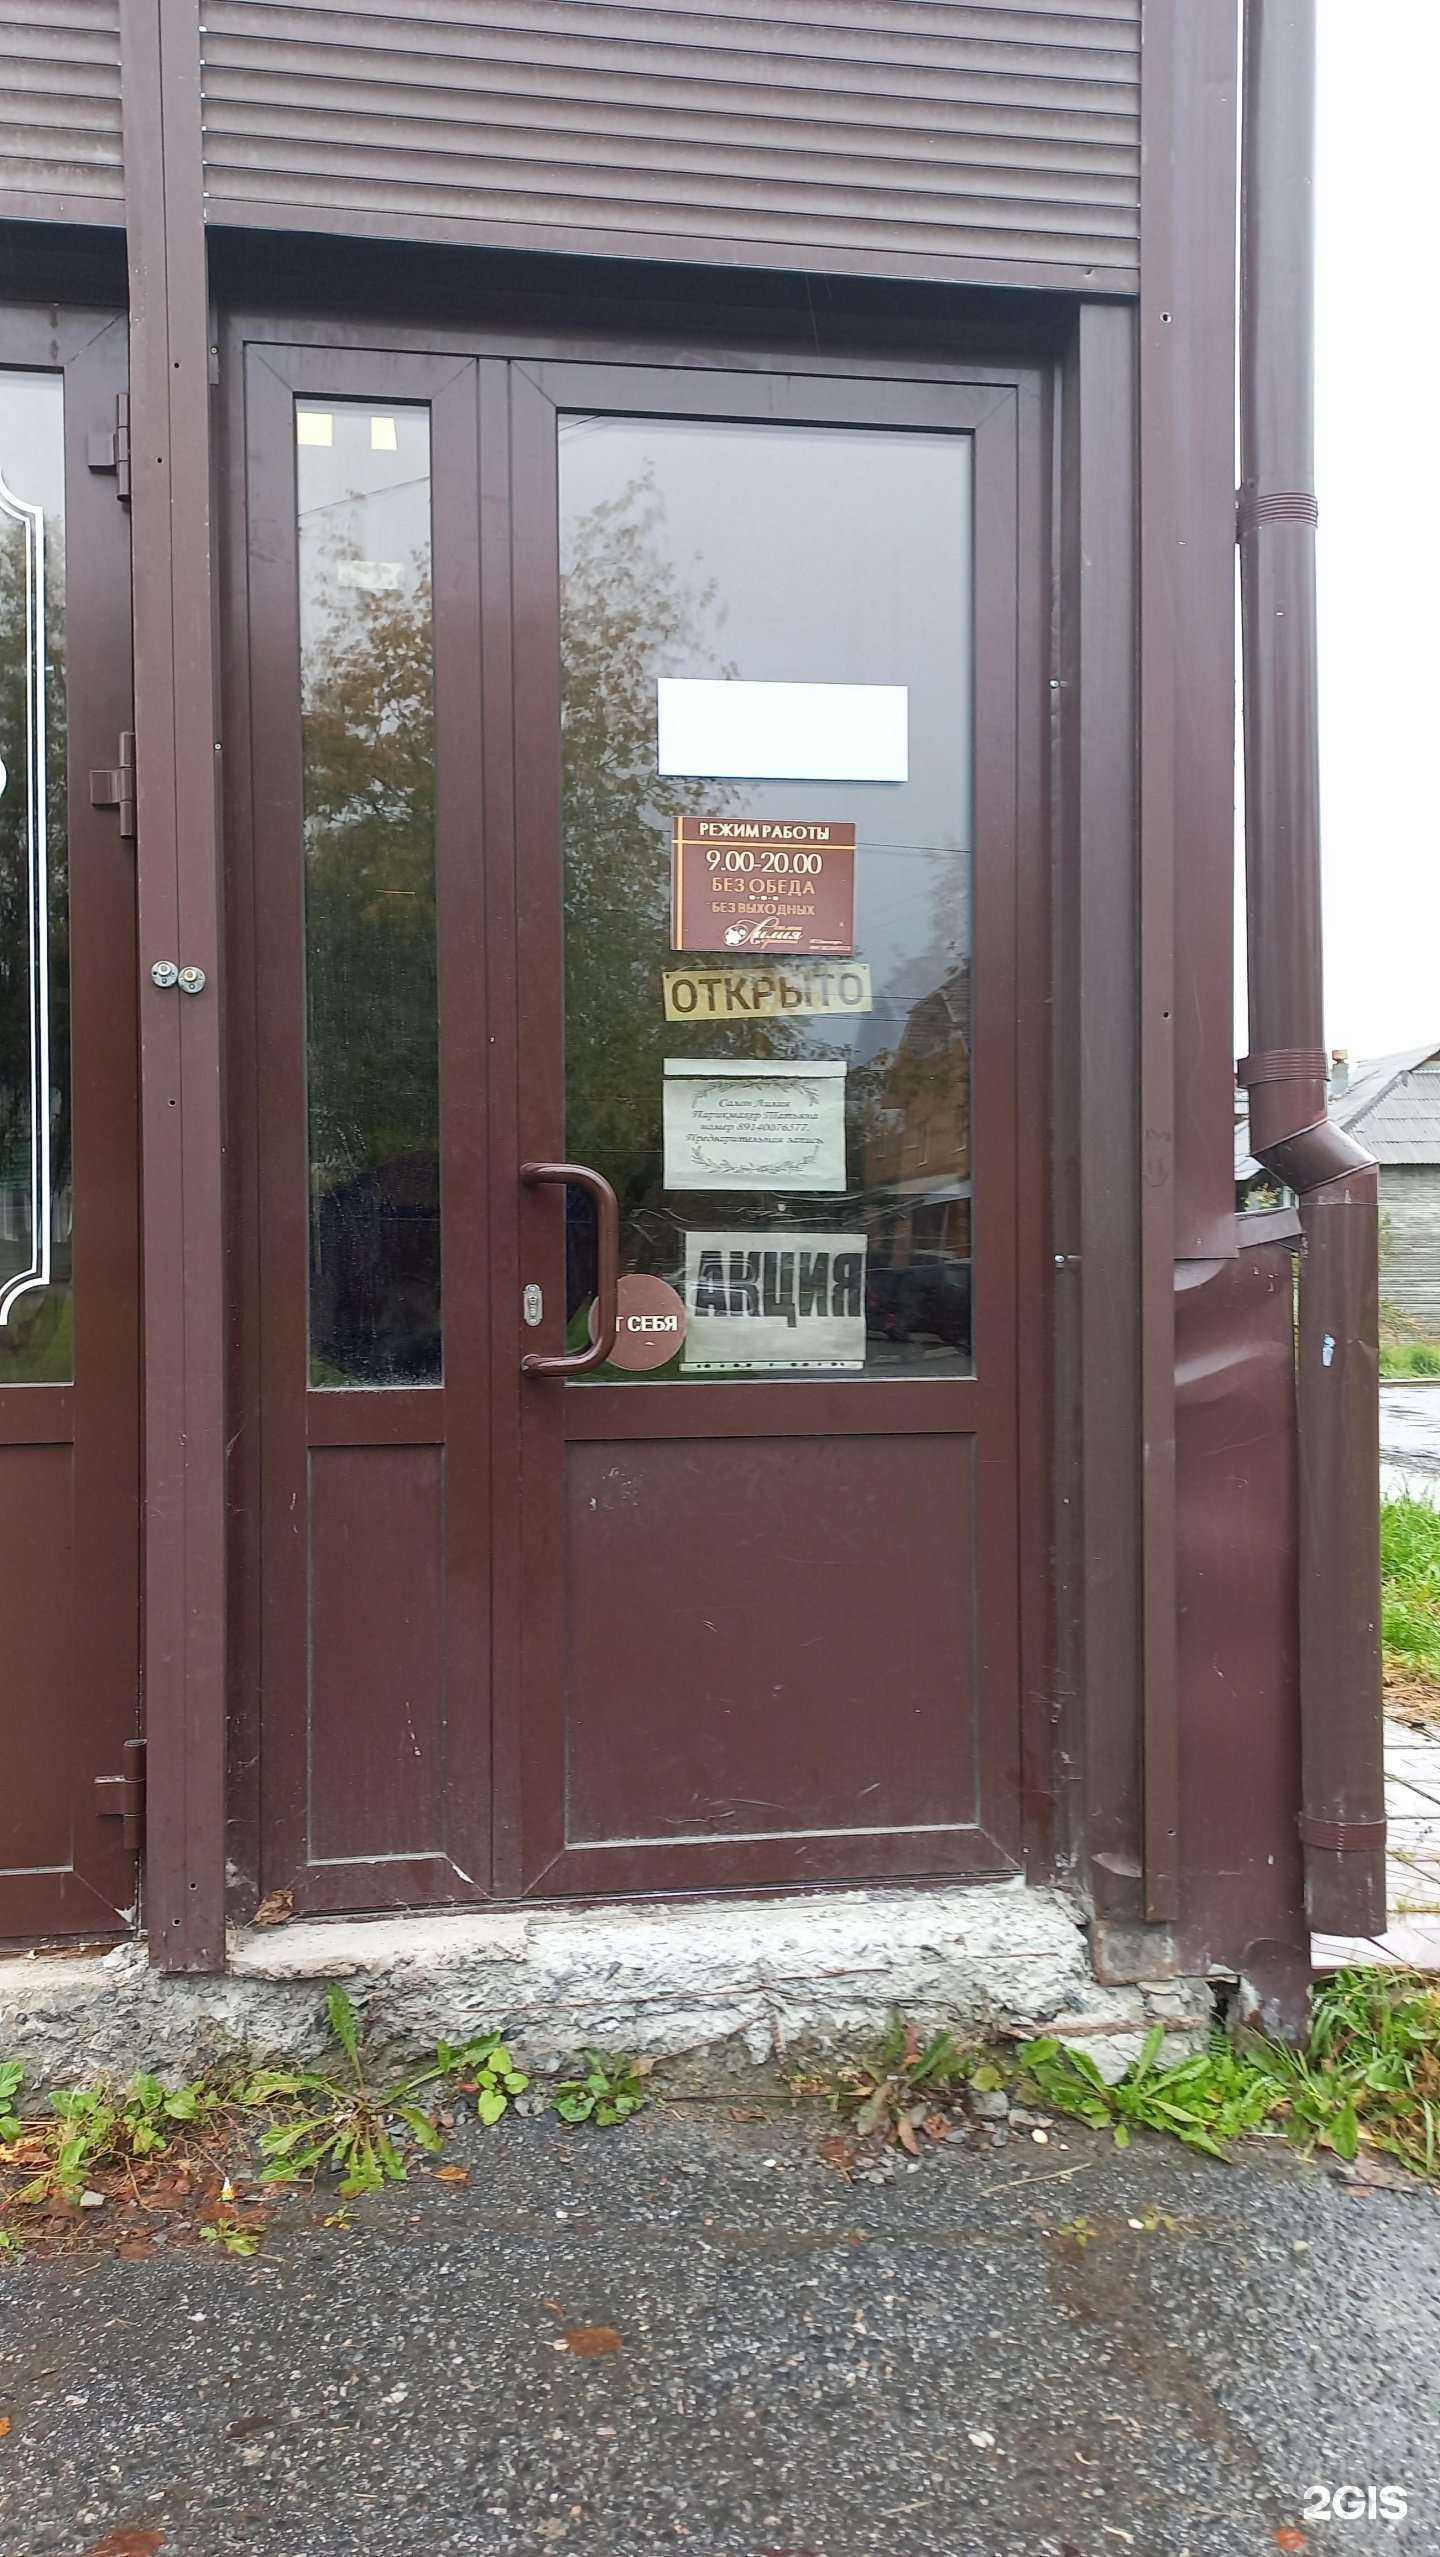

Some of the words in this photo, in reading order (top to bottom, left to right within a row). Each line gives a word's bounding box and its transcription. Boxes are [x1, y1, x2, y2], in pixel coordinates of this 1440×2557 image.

[699, 822, 760, 838] РЕЖИМ
[762, 824, 830, 841] РАБОТЫ
[705, 849, 823, 875] 9.00-20.00
[712, 877, 745, 893] БЕЗ
[748, 878, 816, 897] ОБЕДА
[711, 901, 736, 913] БЕЗ
[737, 902, 816, 917] ВЫХОДНЫХ
[671, 972, 864, 1013] ОТКРЫТО
[695, 1250, 864, 1328] АКЦИЯ
[627, 1315, 678, 1332] СЕБЯ
